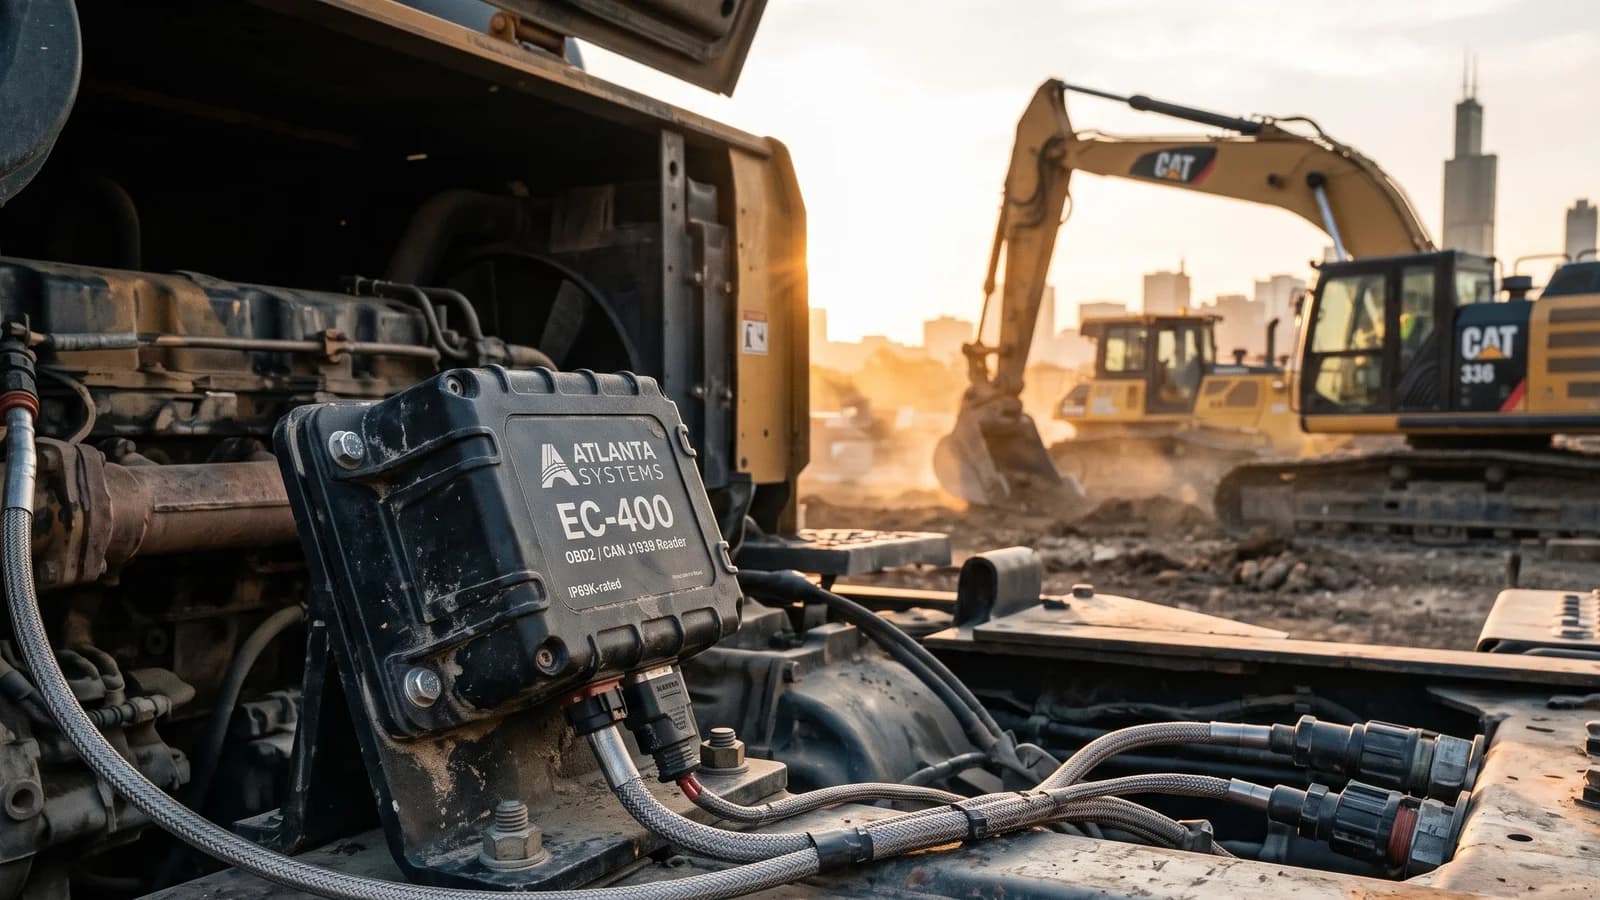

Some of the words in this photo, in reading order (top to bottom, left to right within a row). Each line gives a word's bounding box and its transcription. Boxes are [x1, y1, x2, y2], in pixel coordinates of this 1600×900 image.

[1154, 152, 1196, 182] CAT
[1462, 325, 1519, 360] CAT
[1460, 363, 1495, 384] 336
[574, 441, 656, 464] ATLANTA
[579, 463, 664, 485] SYSTEMS
[556, 494, 674, 540] EC-400
[565, 548, 596, 564] OBD2
[603, 544, 626, 559] CAN
[628, 539, 655, 555] J1939
[655, 535, 687, 551] Reader
[568, 577, 622, 599] IP69K-rated
